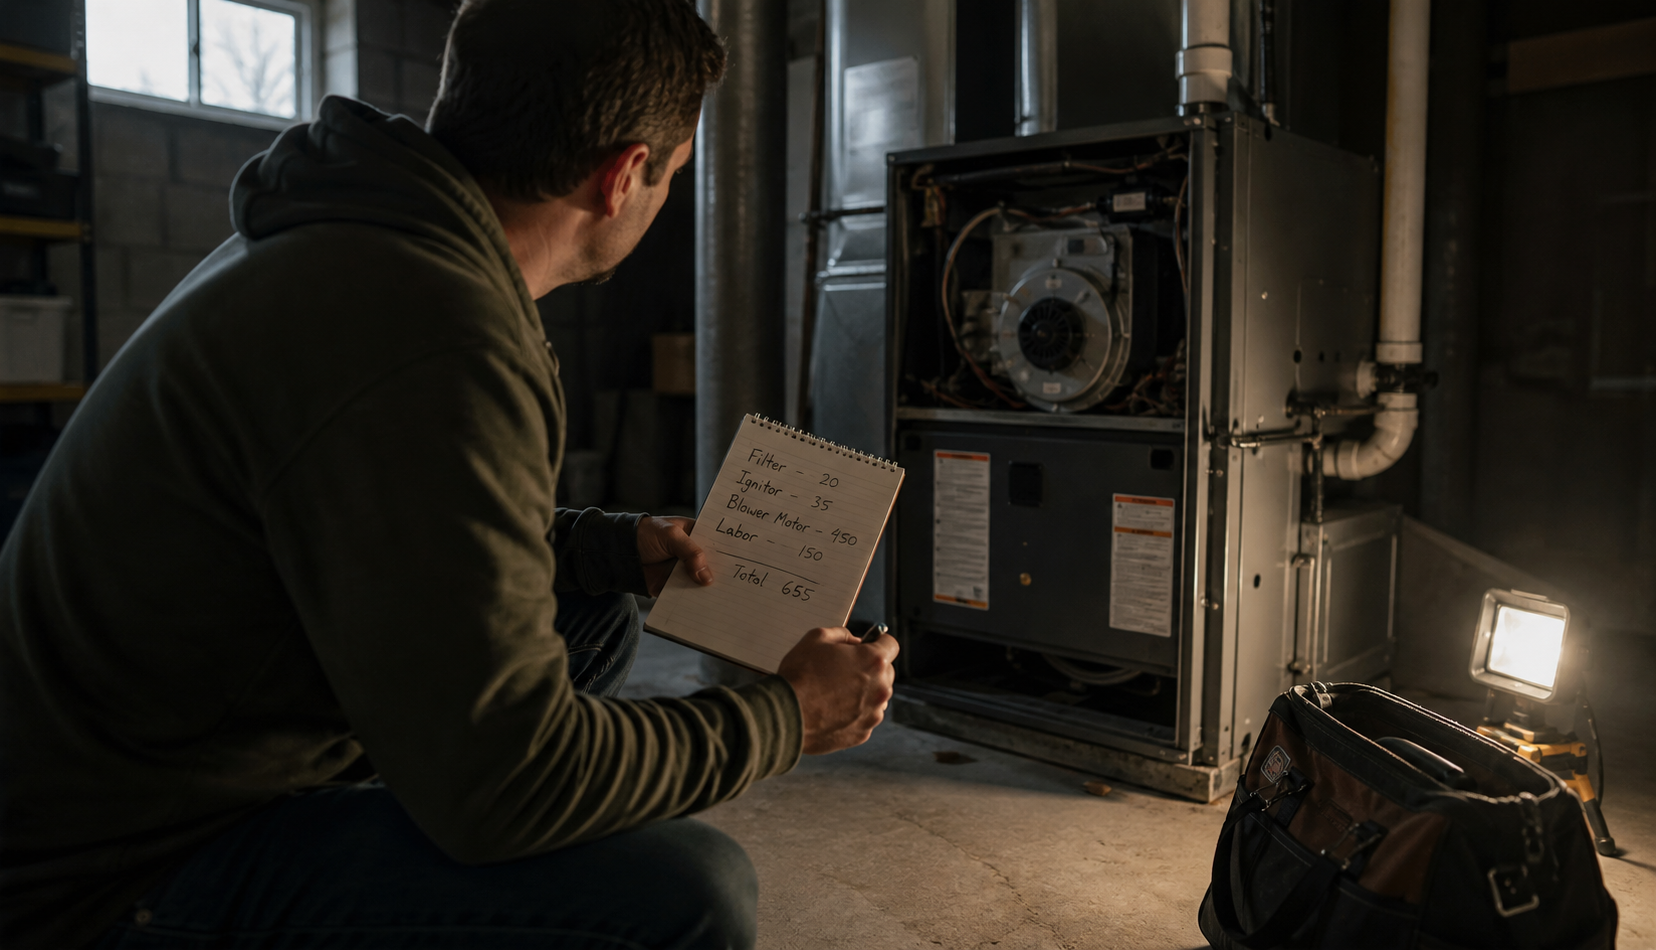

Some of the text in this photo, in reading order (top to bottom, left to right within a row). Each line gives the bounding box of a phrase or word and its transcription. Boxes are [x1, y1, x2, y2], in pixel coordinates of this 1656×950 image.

[748, 448, 787, 472] Filter
[819, 473, 839, 488] 20
[736, 469, 783, 497] Ignitor
[811, 496, 833, 511] 35
[716, 518, 759, 543] Labor
[798, 545, 823, 562] 150
[727, 494, 770, 520] Blower
[774, 511, 810, 533] Motor
[831, 528, 858, 546] 450
[733, 563, 816, 601] Total 655
